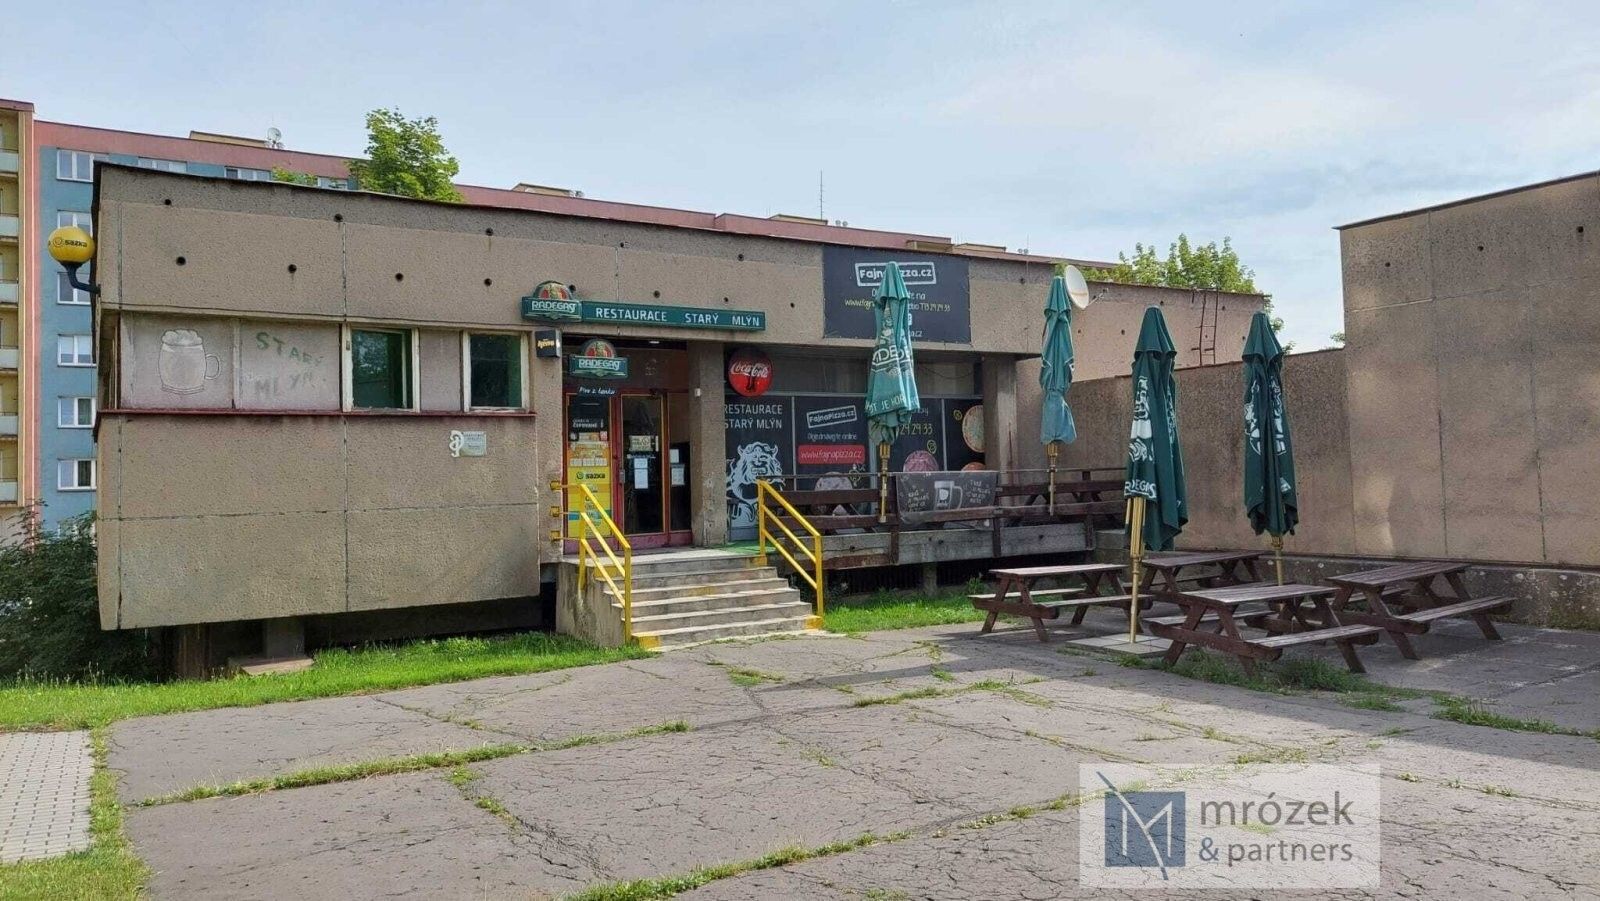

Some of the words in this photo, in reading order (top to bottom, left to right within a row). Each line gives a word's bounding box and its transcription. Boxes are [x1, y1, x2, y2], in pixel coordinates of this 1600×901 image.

[595, 307, 667, 322] RESTAURACE
[685, 312, 719, 324] STARÝ
[732, 315, 760, 326] MLÝN
[756, 417, 782, 429] MLÝN
